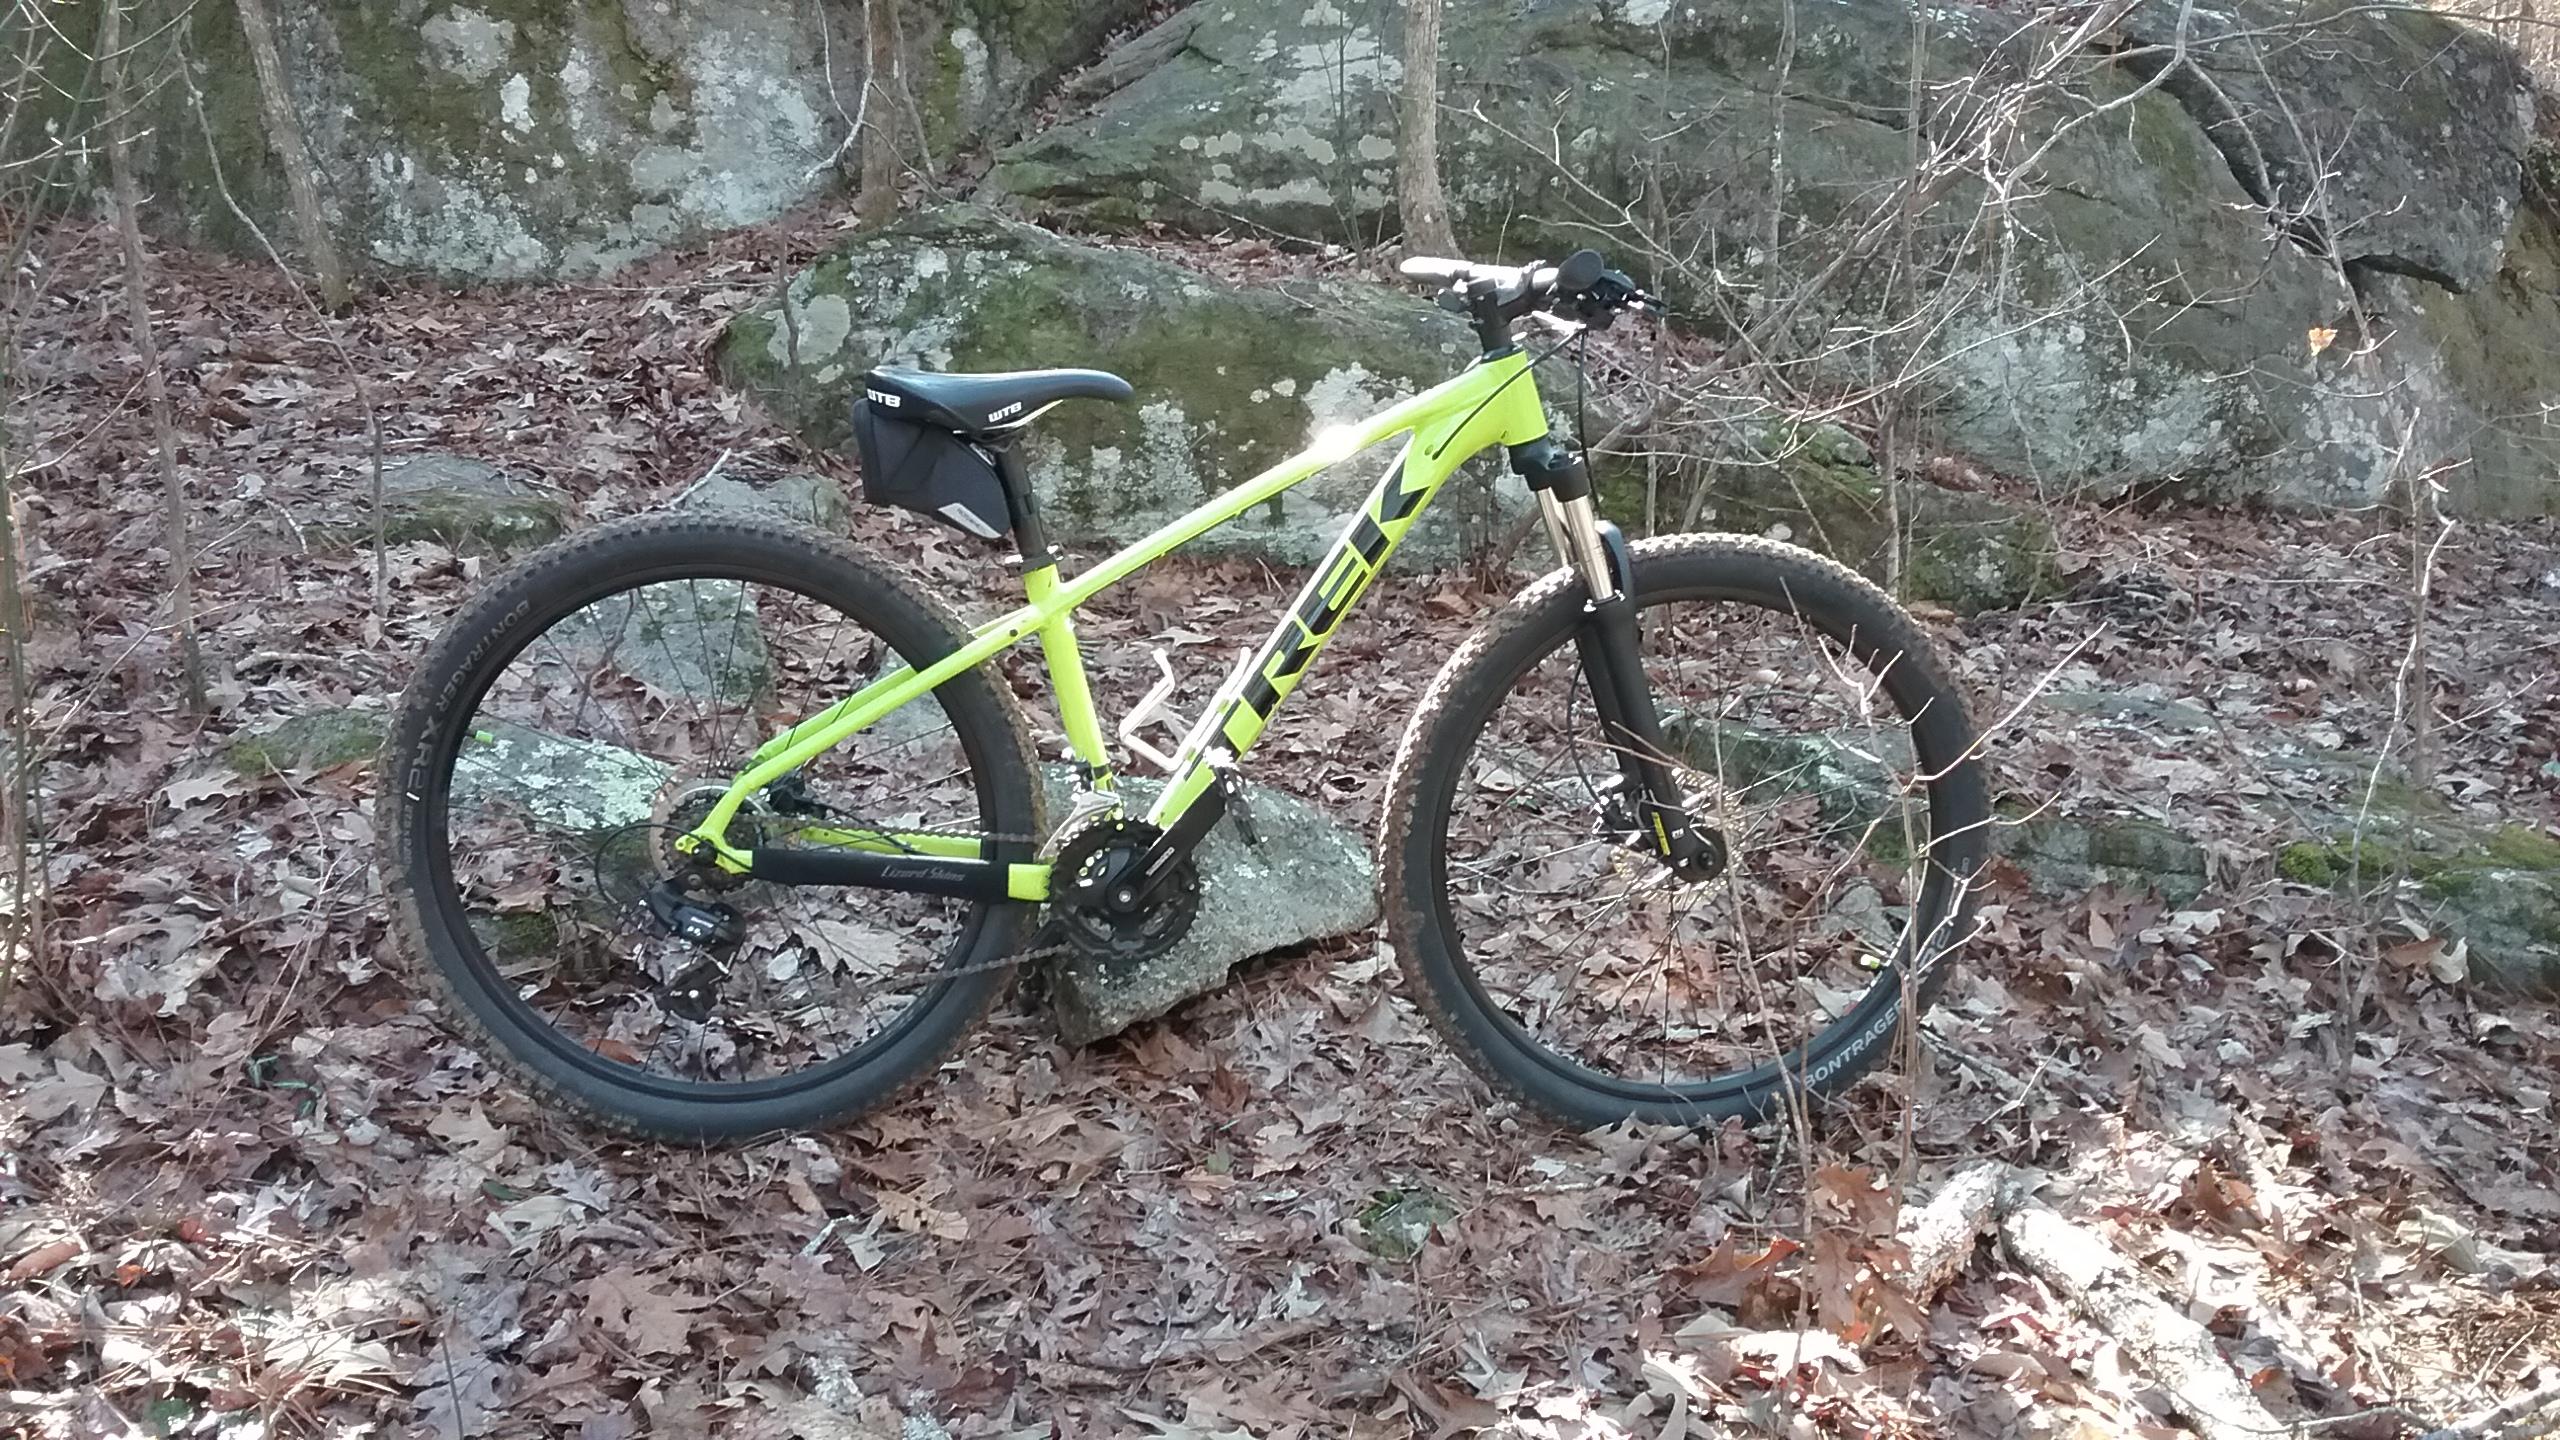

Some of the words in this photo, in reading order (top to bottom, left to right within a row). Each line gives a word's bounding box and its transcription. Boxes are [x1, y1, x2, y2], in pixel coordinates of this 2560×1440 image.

[988, 401, 1022, 423] WTB
[1183, 455, 1430, 781] TREK
[436, 599, 531, 711] BONTRAGER
[881, 865, 929, 880] Lizard
[929, 867, 966, 881] Skins
